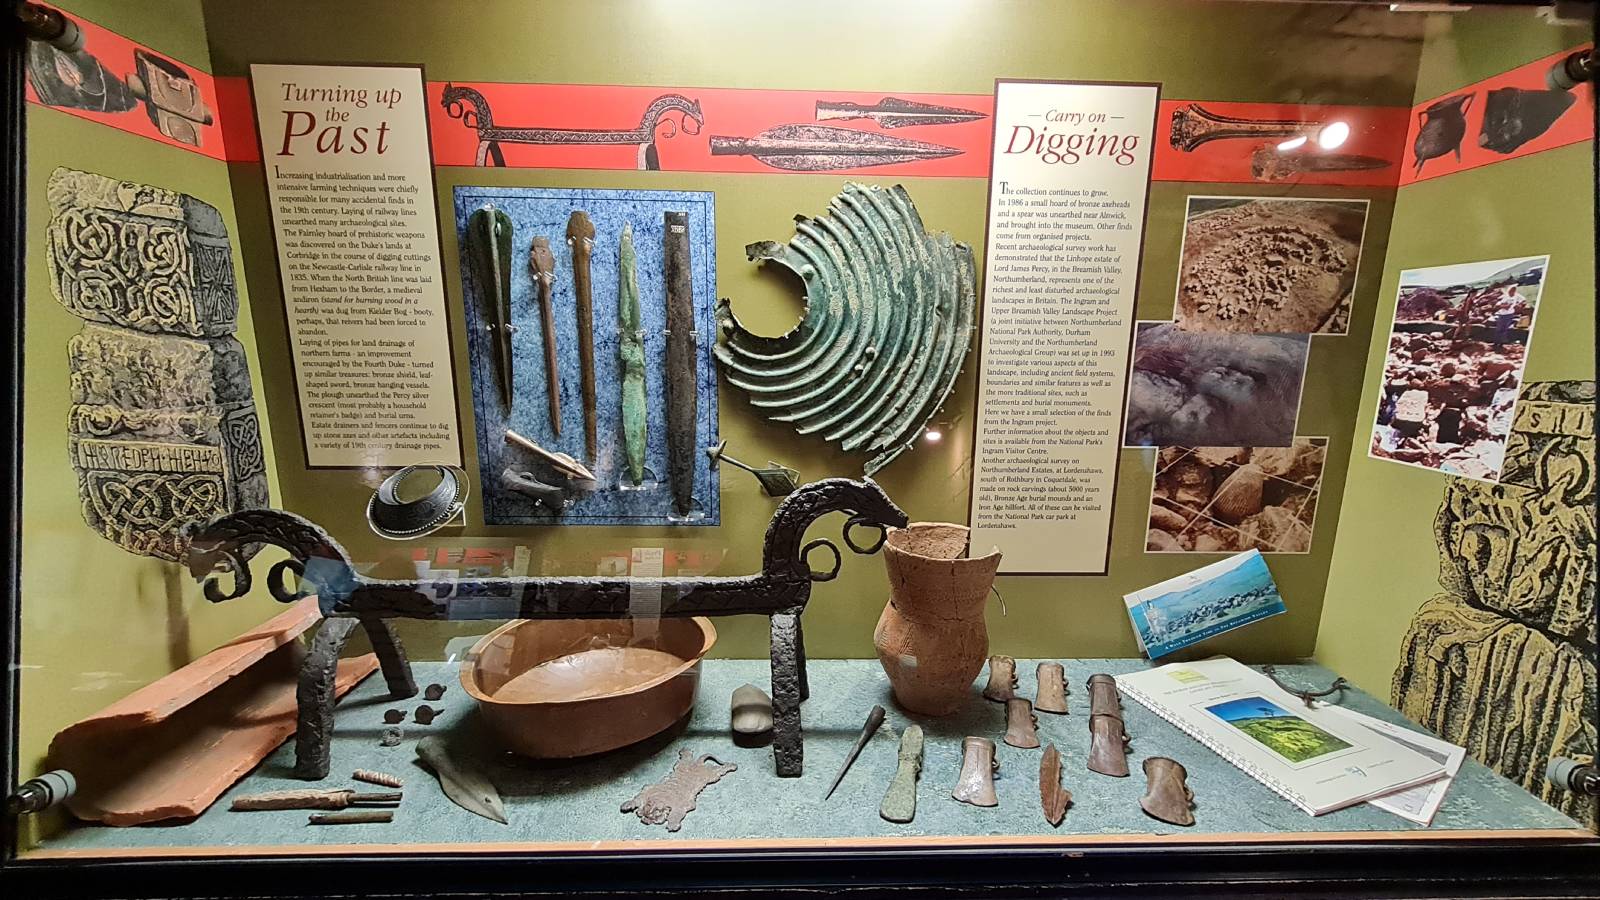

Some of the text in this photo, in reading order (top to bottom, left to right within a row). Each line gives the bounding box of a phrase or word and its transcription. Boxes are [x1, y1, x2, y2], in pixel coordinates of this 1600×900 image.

[282, 83, 402, 109] Turning up
[326, 107, 350, 122] the
[1046, 109, 1106, 126] Carry on
[276, 110, 390, 156] Past
[1004, 125, 1140, 166] Digging
[1000, 182, 1013, 194] The
[1016, 187, 1046, 195] collection
[1048, 188, 1080, 196] continues
[1030, 199, 1047, 207] small
[1049, 199, 1068, 207] hoard
[1078, 200, 1100, 208] bronze
[1010, 221, 1035, 231] brought
[1096, 222, 1115, 230] Other
[1032, 232, 1063, 242] organised
[1064, 233, 1092, 243] projects.
[995, 243, 1016, 251] Recent
[1018, 243, 1063, 253] archaeological
[1088, 244, 1103, 252] work
[994, 254, 1038, 262] demonstrated
[1066, 255, 1092, 264] Linhope
[1094, 255, 1112, 263] estate
[1010, 264, 1029, 272] James
[1031, 264, 1050, 274] Percy,
[1072, 265, 1101, 273] Breamish
[1104, 266, 1122, 276] Valley,
[991, 307, 1117, 318] Upper Breamish Valley Landscape Project
[989, 327, 1015, 336] National
[1032, 328, 1065, 338] Authority,
[1064, 328, 1090, 336] Durham
[988, 338, 1020, 348] University
[1046, 338, 1097, 347] Northumberland
[986, 368, 1018, 378] landscape,
[1020, 369, 1049, 378] including
[1050, 369, 1073, 377] ancient
[986, 378, 1020, 386] boundaries
[1074, 428, 1095, 438] objects
[992, 503, 1003, 513] Age
